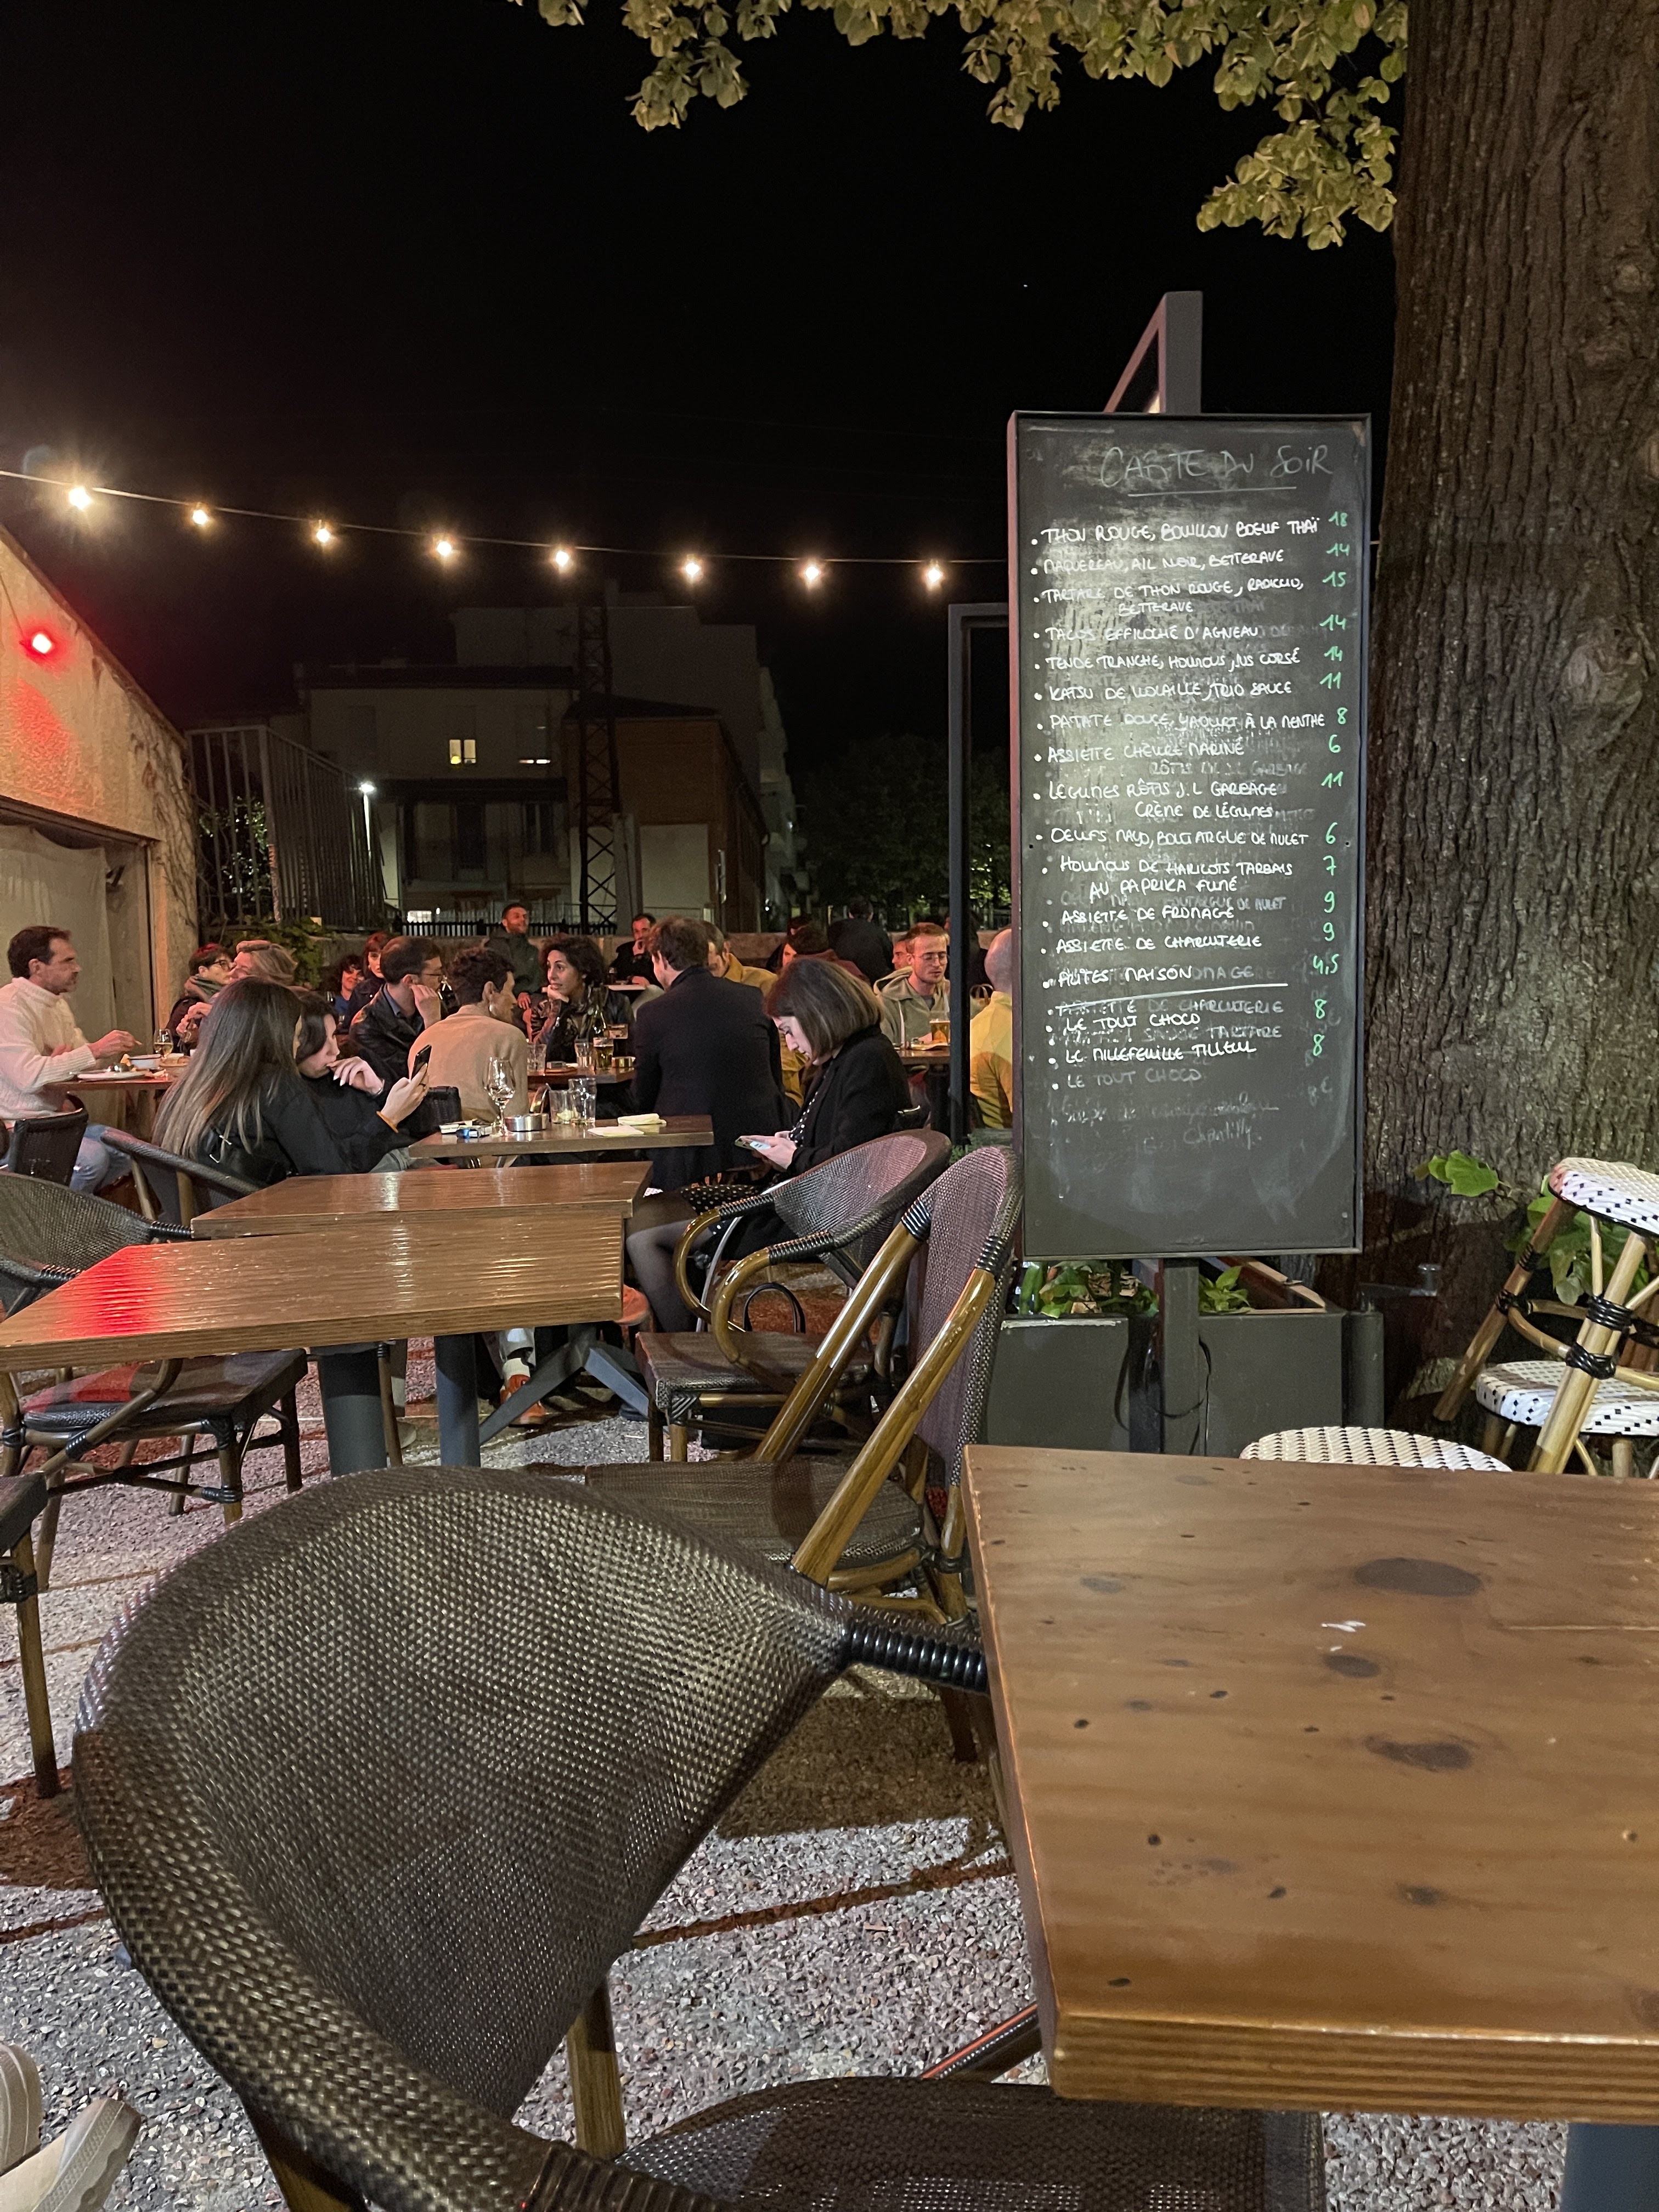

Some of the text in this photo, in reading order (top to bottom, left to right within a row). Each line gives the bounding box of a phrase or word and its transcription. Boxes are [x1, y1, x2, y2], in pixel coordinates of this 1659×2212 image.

[1100, 446, 1208, 488] CARTE
[1220, 450, 1254, 478] DU
[1041, 528, 1086, 544] THON
[1095, 524, 1156, 541] ROUGE,
[1160, 523, 1229, 541] BOUILLON
[1328, 511, 1348, 527] 18
[1131, 557, 1157, 571] AIL
[1208, 549, 1284, 567] BETTERAVE
[1325, 542, 1350, 557] 14
[1041, 589, 1106, 603] TARTARE
[1114, 586, 1135, 599] DE
[1138, 583, 1181, 597] THON
[1322, 570, 1347, 588] 15
[1118, 601, 1193, 617] BETTERAVE
[1045, 627, 1096, 641] TACOS
[1319, 614, 1347, 631] 14
[1045, 657, 1094, 670] TENDE
[1096, 654, 1164, 670] TRANCHE,
[1323, 646, 1343, 662] 14
[1049, 686, 1094, 701] KATSU
[1105, 687, 1126, 700] DE
[1250, 681, 1292, 696] SAUCE
[1319, 671, 1341, 690] 11
[1049, 714, 1113, 730] PATATE
[1260, 715, 1277, 730] LA
[1282, 713, 1326, 729] MENTHE
[1336, 707, 1348, 725] 8
[1047, 746, 1115, 763] ASSIETTE
[1188, 736, 1245, 757] MARINÉ
[1328, 734, 1341, 754] 6
[1126, 778, 1170, 798] RÔTIS
[1321, 771, 1344, 789] 11
[1192, 805, 1212, 818] DE
[1116, 829, 1154, 849] MAYO,
[1250, 832, 1267, 845] DE
[1270, 832, 1310, 846] MULET
[1325, 822, 1338, 844] 6
[1060, 854, 1337, 877] HOUMOUS DE HARICOTS TARBAIS 7
[1089, 876, 1238, 905] AU PAPRIKA FUMÉ
[1061, 890, 1335, 926] ASSIETTE DE FROMAGE 9
[1056, 922, 1335, 954] ASSIETTE DE CHARCUTERIE 9
[1125, 965, 1193, 982] MAISON
[1312, 953, 1340, 975] 4,5
[1066, 998, 1327, 1031] LE TOUT CHOCO 8
[1065, 1049, 1084, 1064] LE
[1191, 1040, 1257, 1057] TILLEUL
[1312, 1034, 1325, 1057] 8
